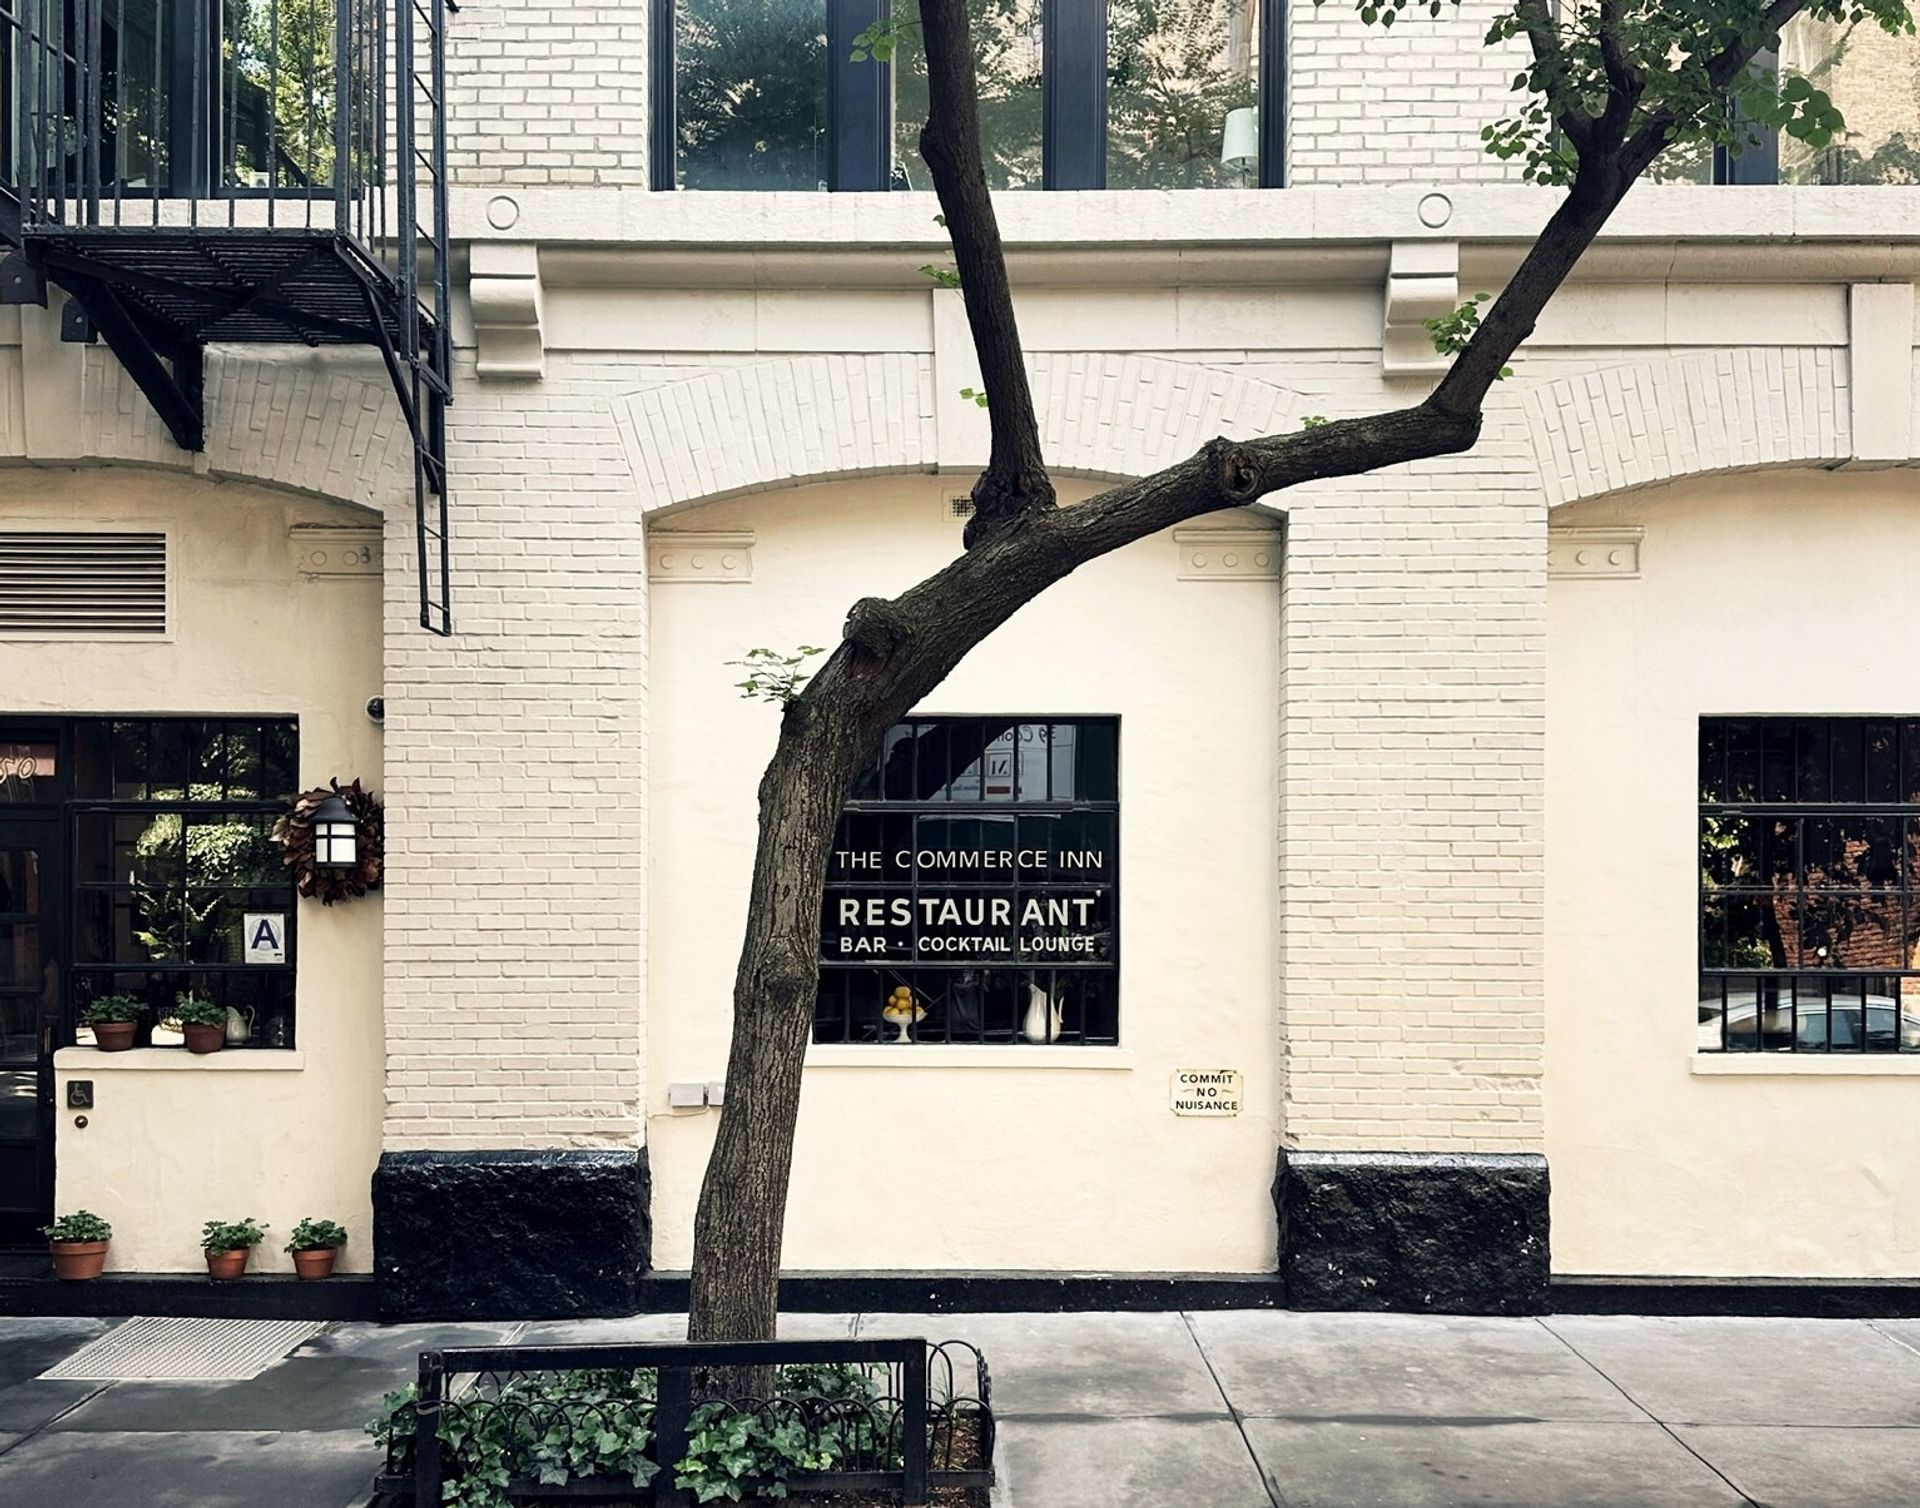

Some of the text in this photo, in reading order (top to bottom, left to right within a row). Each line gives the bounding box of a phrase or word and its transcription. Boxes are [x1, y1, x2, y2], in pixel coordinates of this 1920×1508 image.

[836, 850, 1103, 869] THE COMMERCE INN
[839, 898, 1095, 926] RESTAURANT
[251, 919, 279, 949] A
[840, 936, 1095, 952] BAR COCKTAIL LOUNGE
[1180, 1074, 1233, 1083] COMMIT
[1196, 1087, 1217, 1097] NO
[1176, 1101, 1238, 1110] NUISANCE
